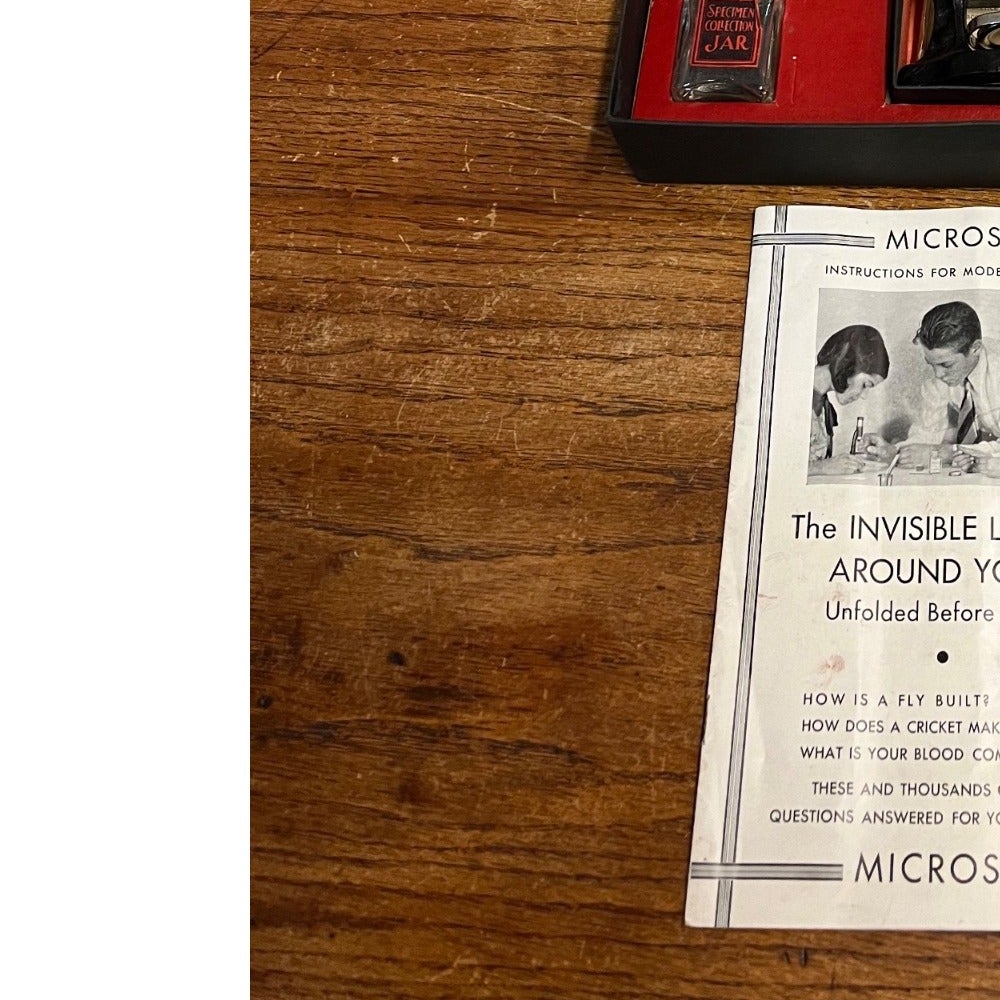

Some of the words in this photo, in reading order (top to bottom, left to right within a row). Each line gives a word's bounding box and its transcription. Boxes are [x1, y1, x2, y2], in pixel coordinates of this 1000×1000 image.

[706, 4, 754, 18] SPECIMEN
[704, 20, 754, 32] COLLECTION
[704, 34, 749, 53] JAR
[825, 264, 924, 279] INSTRUCTIONS
[931, 267, 957, 278] FOR
[791, 512, 837, 540] The
[850, 515, 977, 541] INVISIBLE
[829, 557, 962, 585] AROUND
[826, 600, 919, 622] Unfolded
[928, 601, 995, 622] Before
[802, 692, 846, 706] HOW
[853, 693, 869, 706] IS
[877, 694, 888, 707] A
[898, 694, 926, 707] FLY
[935, 694, 990, 707] BUILT?
[801, 719, 840, 732] HOW
[845, 719, 884, 733] DOES
[890, 721, 901, 734] A
[906, 720, 962, 734] CRICKET
[800, 746, 843, 760] WHAT
[849, 747, 861, 761] IS
[868, 747, 908, 761] YOUR
[914, 747, 964, 762] BLOOD
[811, 781, 854, 795] THESE
[860, 782, 894, 796] AND
[900, 782, 991, 797] THOUSANDS
[769, 809, 854, 824] QUESTIONS
[861, 810, 944, 825] ANSWERED
[952, 811, 980, 825] FOR
